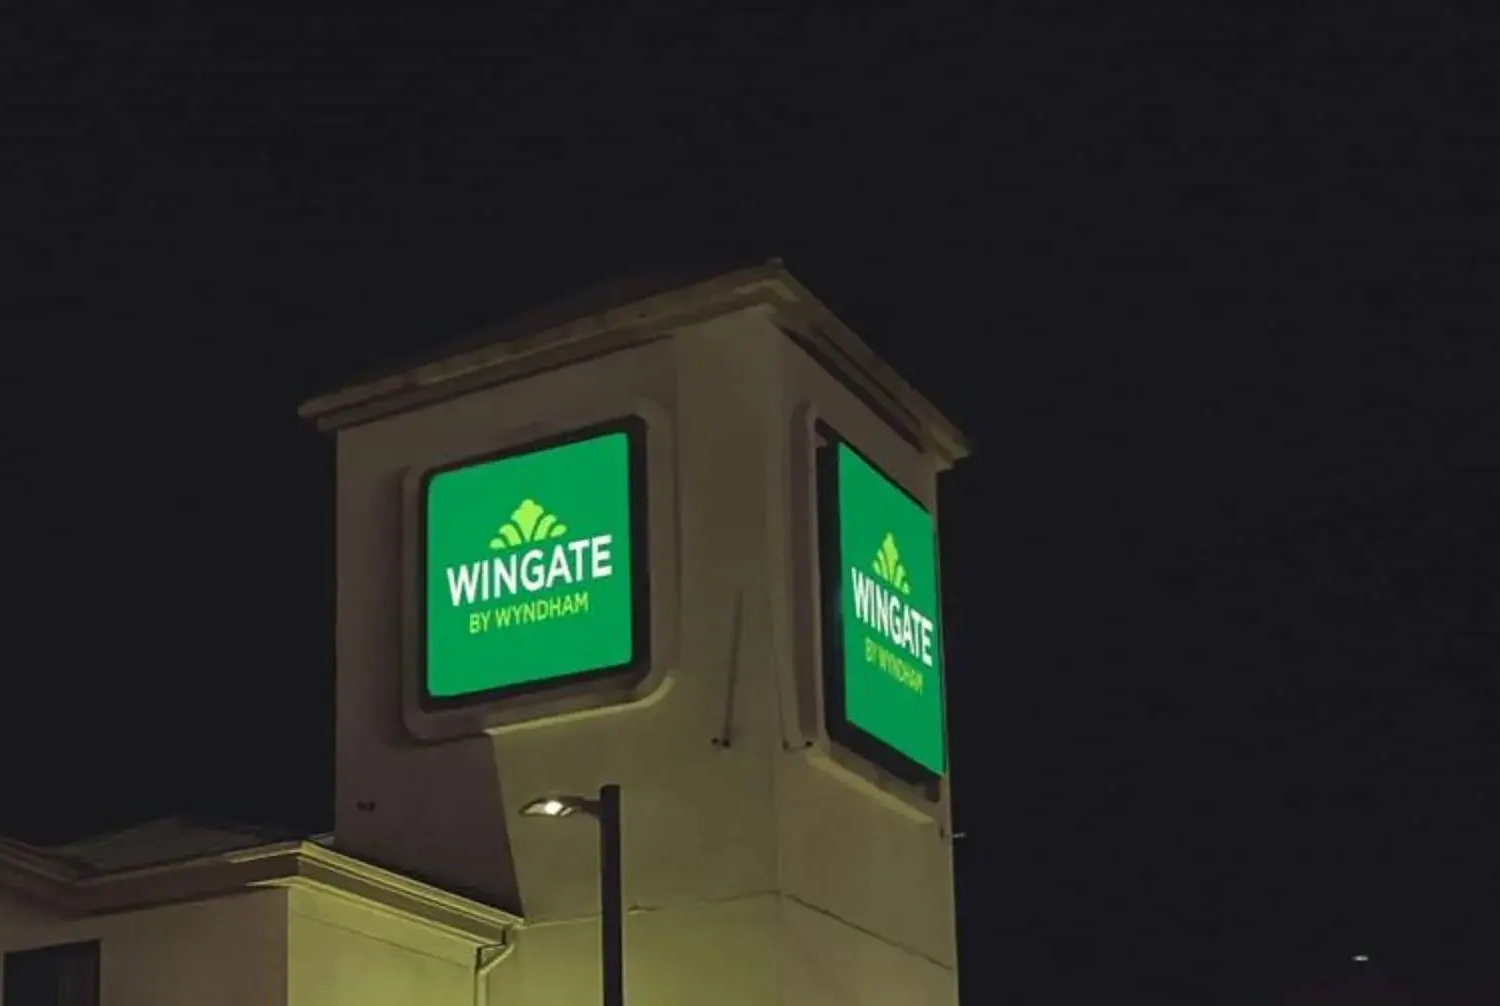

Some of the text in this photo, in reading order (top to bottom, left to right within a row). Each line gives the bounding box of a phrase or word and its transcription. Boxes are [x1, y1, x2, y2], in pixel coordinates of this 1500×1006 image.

[446, 534, 613, 606] WINGATE
[468, 592, 589, 634] BY WYNDHAM
[851, 566, 933, 668] WINGATE
